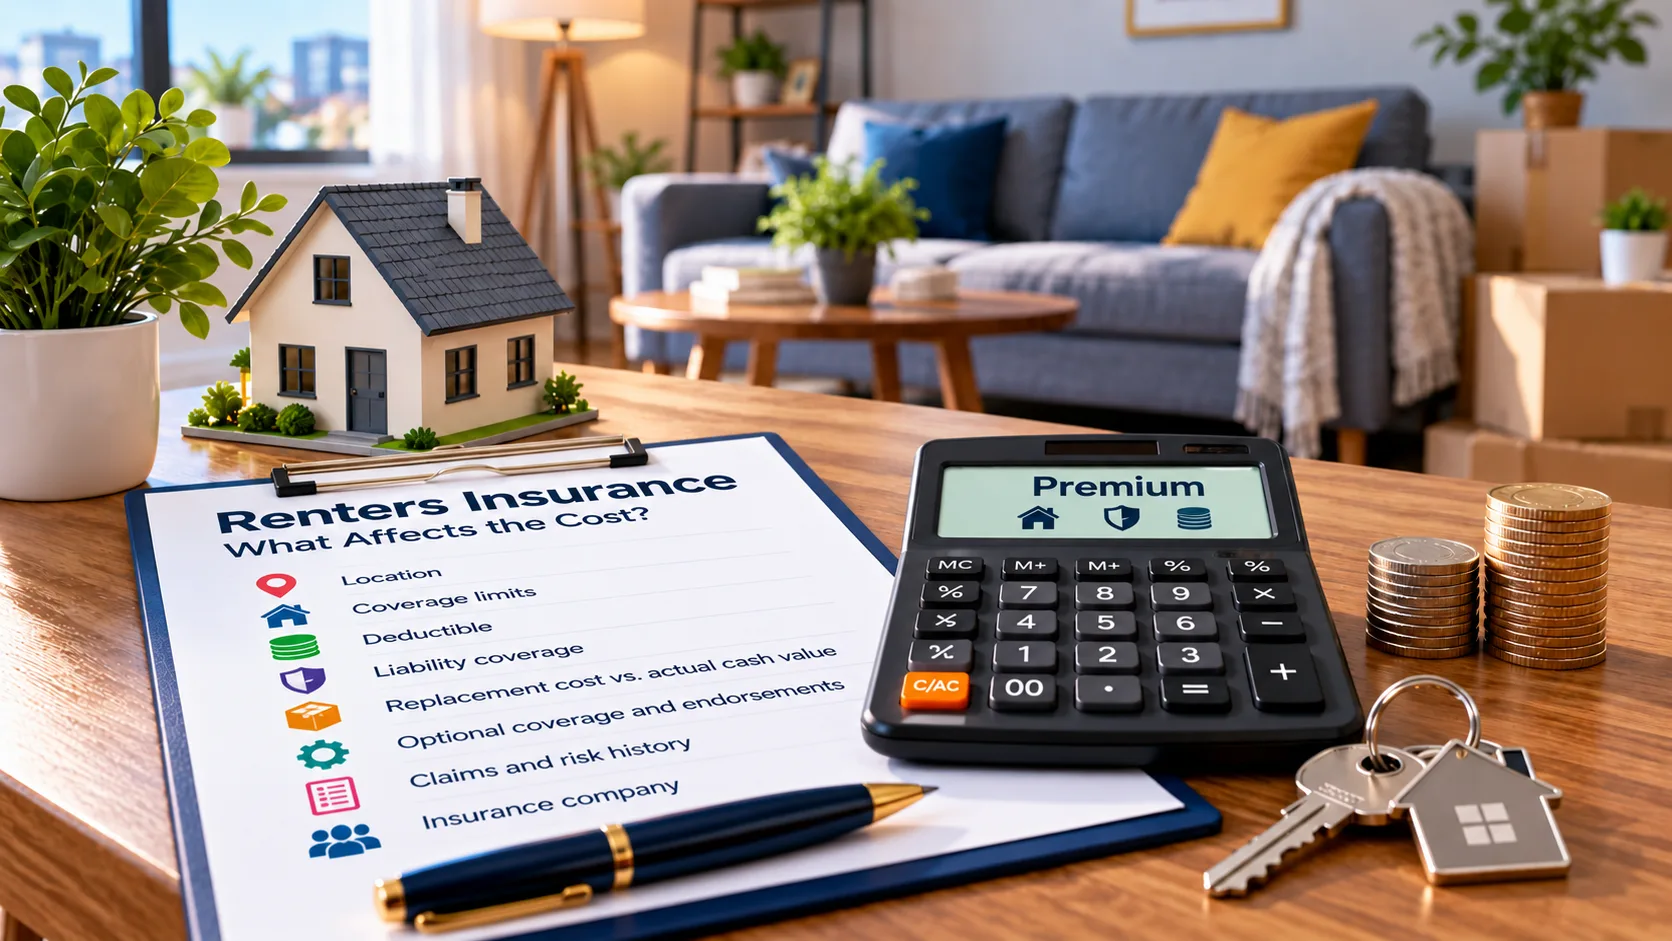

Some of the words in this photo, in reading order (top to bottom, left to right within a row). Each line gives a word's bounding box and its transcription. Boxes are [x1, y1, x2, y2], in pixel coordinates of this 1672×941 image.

[1033, 475, 1205, 497] Premium
[217, 499, 448, 534] Renters
[463, 475, 737, 511] Insurance
[223, 536, 332, 558] What
[344, 525, 478, 548] Affects
[485, 518, 545, 534] the
[555, 507, 649, 527] Cost?
[938, 560, 973, 571] MC
[1014, 560, 1047, 571] M+
[1088, 560, 1121, 571] M+
[1164, 560, 1191, 572] %
[1244, 560, 1271, 572] %
[341, 569, 442, 586] Location
[938, 584, 964, 598] %
[1020, 585, 1038, 600] 7
[1096, 586, 1114, 601] 8
[1172, 586, 1190, 601] 9
[352, 596, 468, 614] Coverage
[474, 589, 536, 602] limits
[1016, 613, 1037, 630] 4
[1097, 614, 1116, 631] 5
[1176, 615, 1196, 632] 6
[362, 622, 493, 646] Deductible
[373, 658, 466, 678] Liability
[474, 646, 584, 665] coverage
[1018, 645, 1030, 663] 1
[1098, 645, 1117, 664] 2
[1181, 646, 1201, 664] 3
[385, 681, 549, 713] Replacement
[554, 675, 605, 690] cost
[610, 672, 643, 683] vs.
[648, 660, 717, 679] actual
[722, 653, 776, 669] cash
[778, 645, 838, 662] value
[913, 678, 960, 693] C/AC
[1005, 678, 1044, 697] 00
[397, 722, 506, 750] Optional
[512, 710, 625, 734] coverage
[632, 699, 677, 717] and
[683, 679, 846, 710] endorsements
[409, 766, 499, 789] Claims
[506, 755, 554, 775] and
[560, 748, 605, 767] risk
[608, 736, 692, 760] history
[422, 800, 554, 830] Insurance
[562, 780, 680, 808] company
